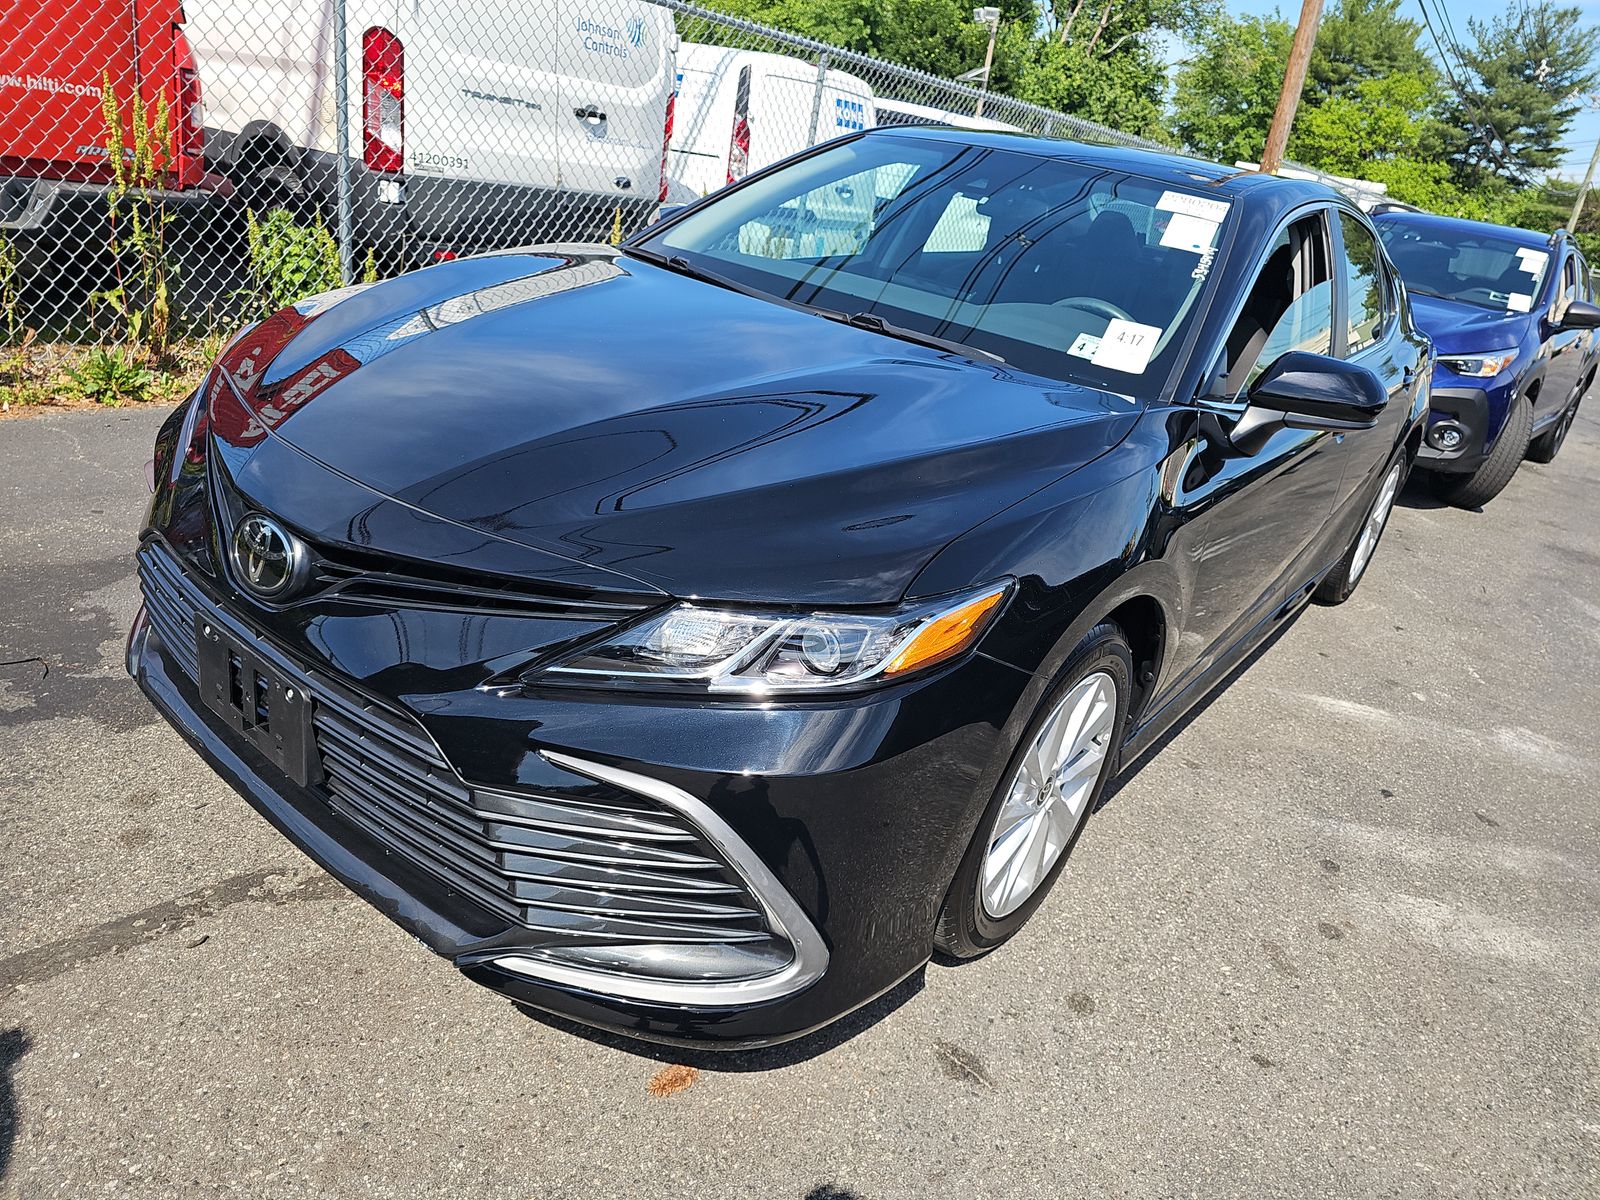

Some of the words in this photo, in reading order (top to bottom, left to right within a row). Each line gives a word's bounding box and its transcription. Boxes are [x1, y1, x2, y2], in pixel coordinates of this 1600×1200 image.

[577, 17, 620, 40] Johnson
[584, 36, 628, 58] Controls
[462, 89, 524, 106] TRANSIT
[409, 151, 469, 170] 41200391
[1077, 342, 1086, 352] 4
[1117, 331, 1144, 347] 4:17
